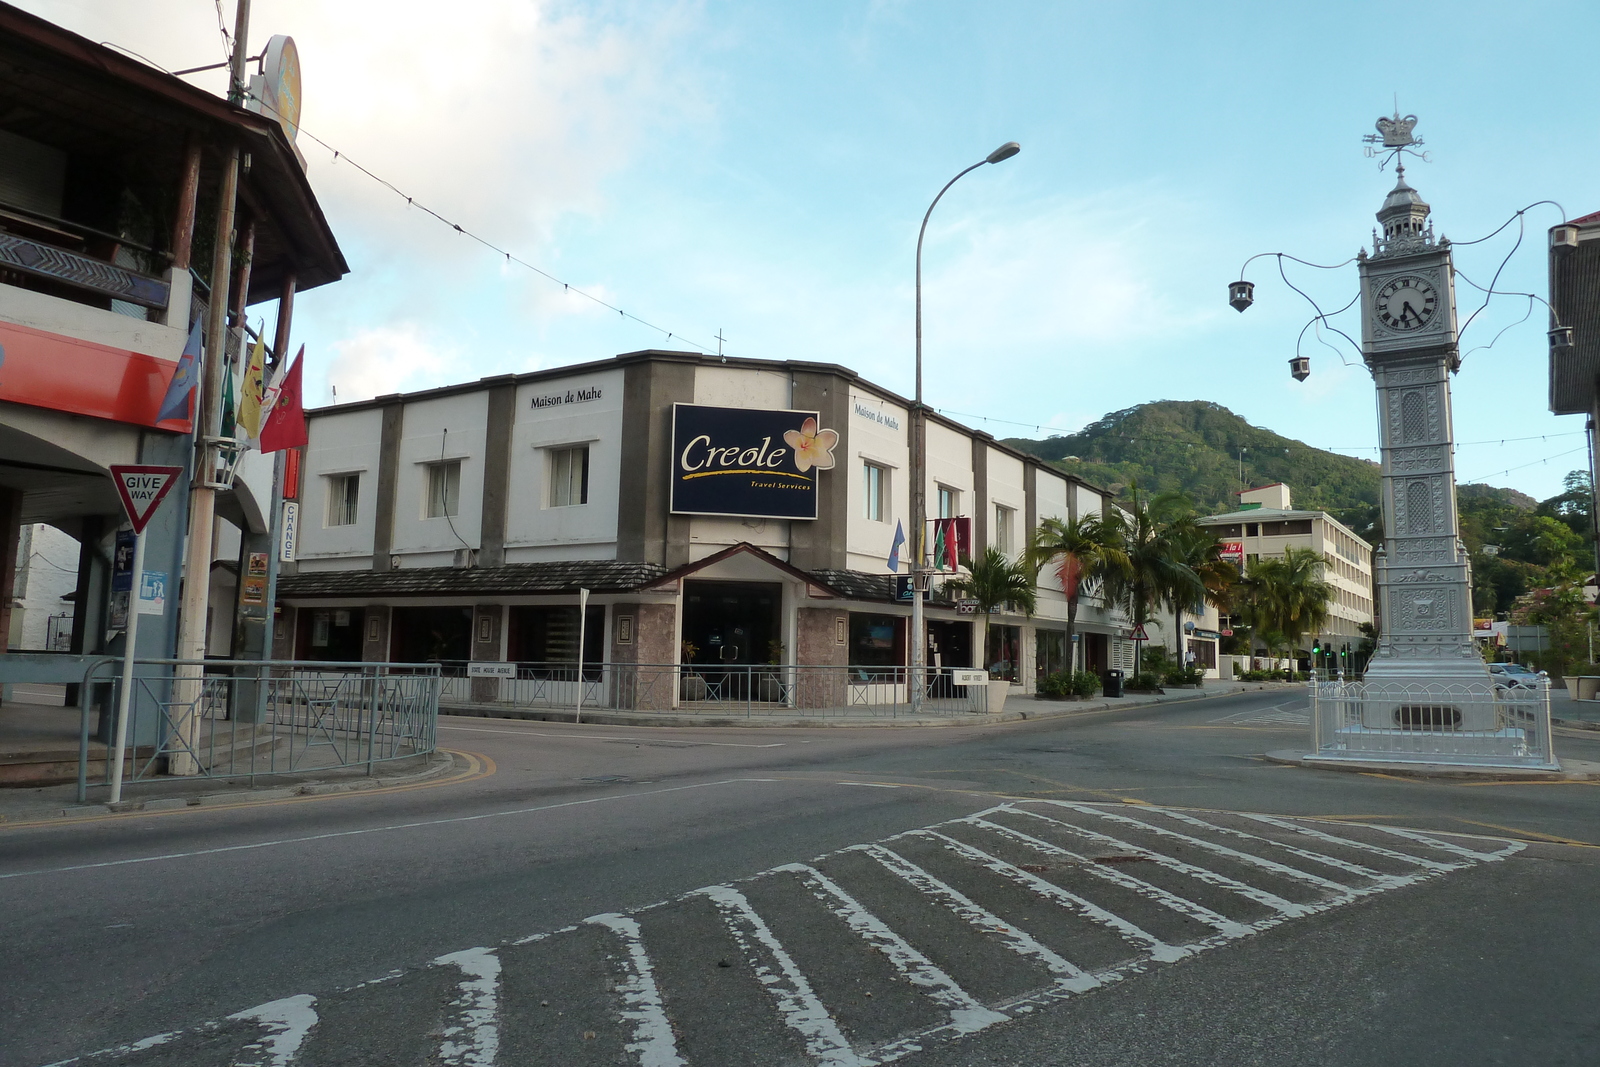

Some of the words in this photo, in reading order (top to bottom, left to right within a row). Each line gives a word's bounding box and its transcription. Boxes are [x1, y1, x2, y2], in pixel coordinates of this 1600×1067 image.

[531, 395, 562, 409] Maison
[564, 390, 575, 404] de
[577, 386, 602, 401] Mahe
[855, 403, 876, 421] Maison
[876, 411, 883, 424] de
[884, 415, 899, 431] Mahe
[681, 434, 787, 472] Creole
[126, 477, 161, 489] GIVE
[751, 480, 777, 489] Travel
[777, 482, 811, 491] Services
[131, 490, 154, 500] WAY
[284, 505, 295, 559] CHANGE
